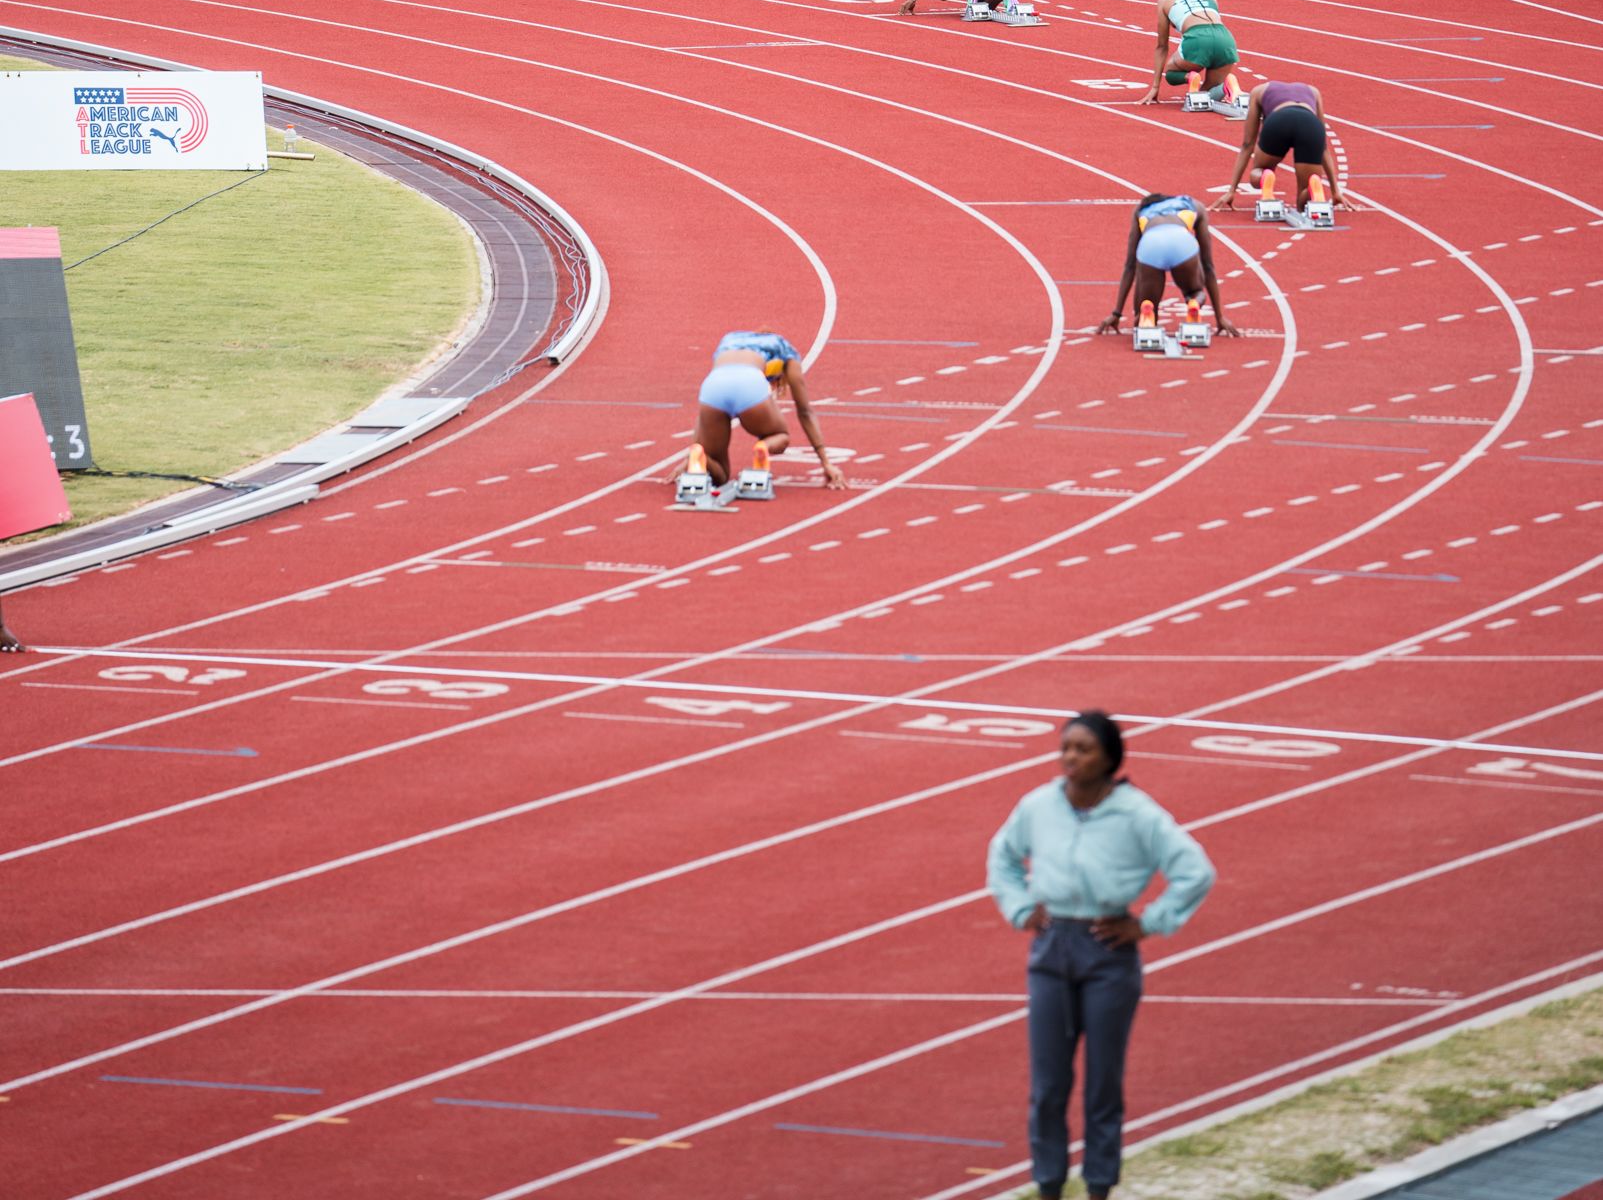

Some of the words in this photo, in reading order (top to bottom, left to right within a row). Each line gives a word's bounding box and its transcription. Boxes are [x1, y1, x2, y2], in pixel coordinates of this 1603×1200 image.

[76, 106, 178, 122] AMERICAN
[77, 123, 143, 138] TRACK
[80, 139, 151, 155] LEAGUE
[64, 425, 85, 459] 3
[98, 664, 248, 685] 2
[362, 678, 510, 700] 3
[645, 695, 794, 716] 4
[899, 713, 1056, 737] 5
[1190, 734, 1342, 759] 6
